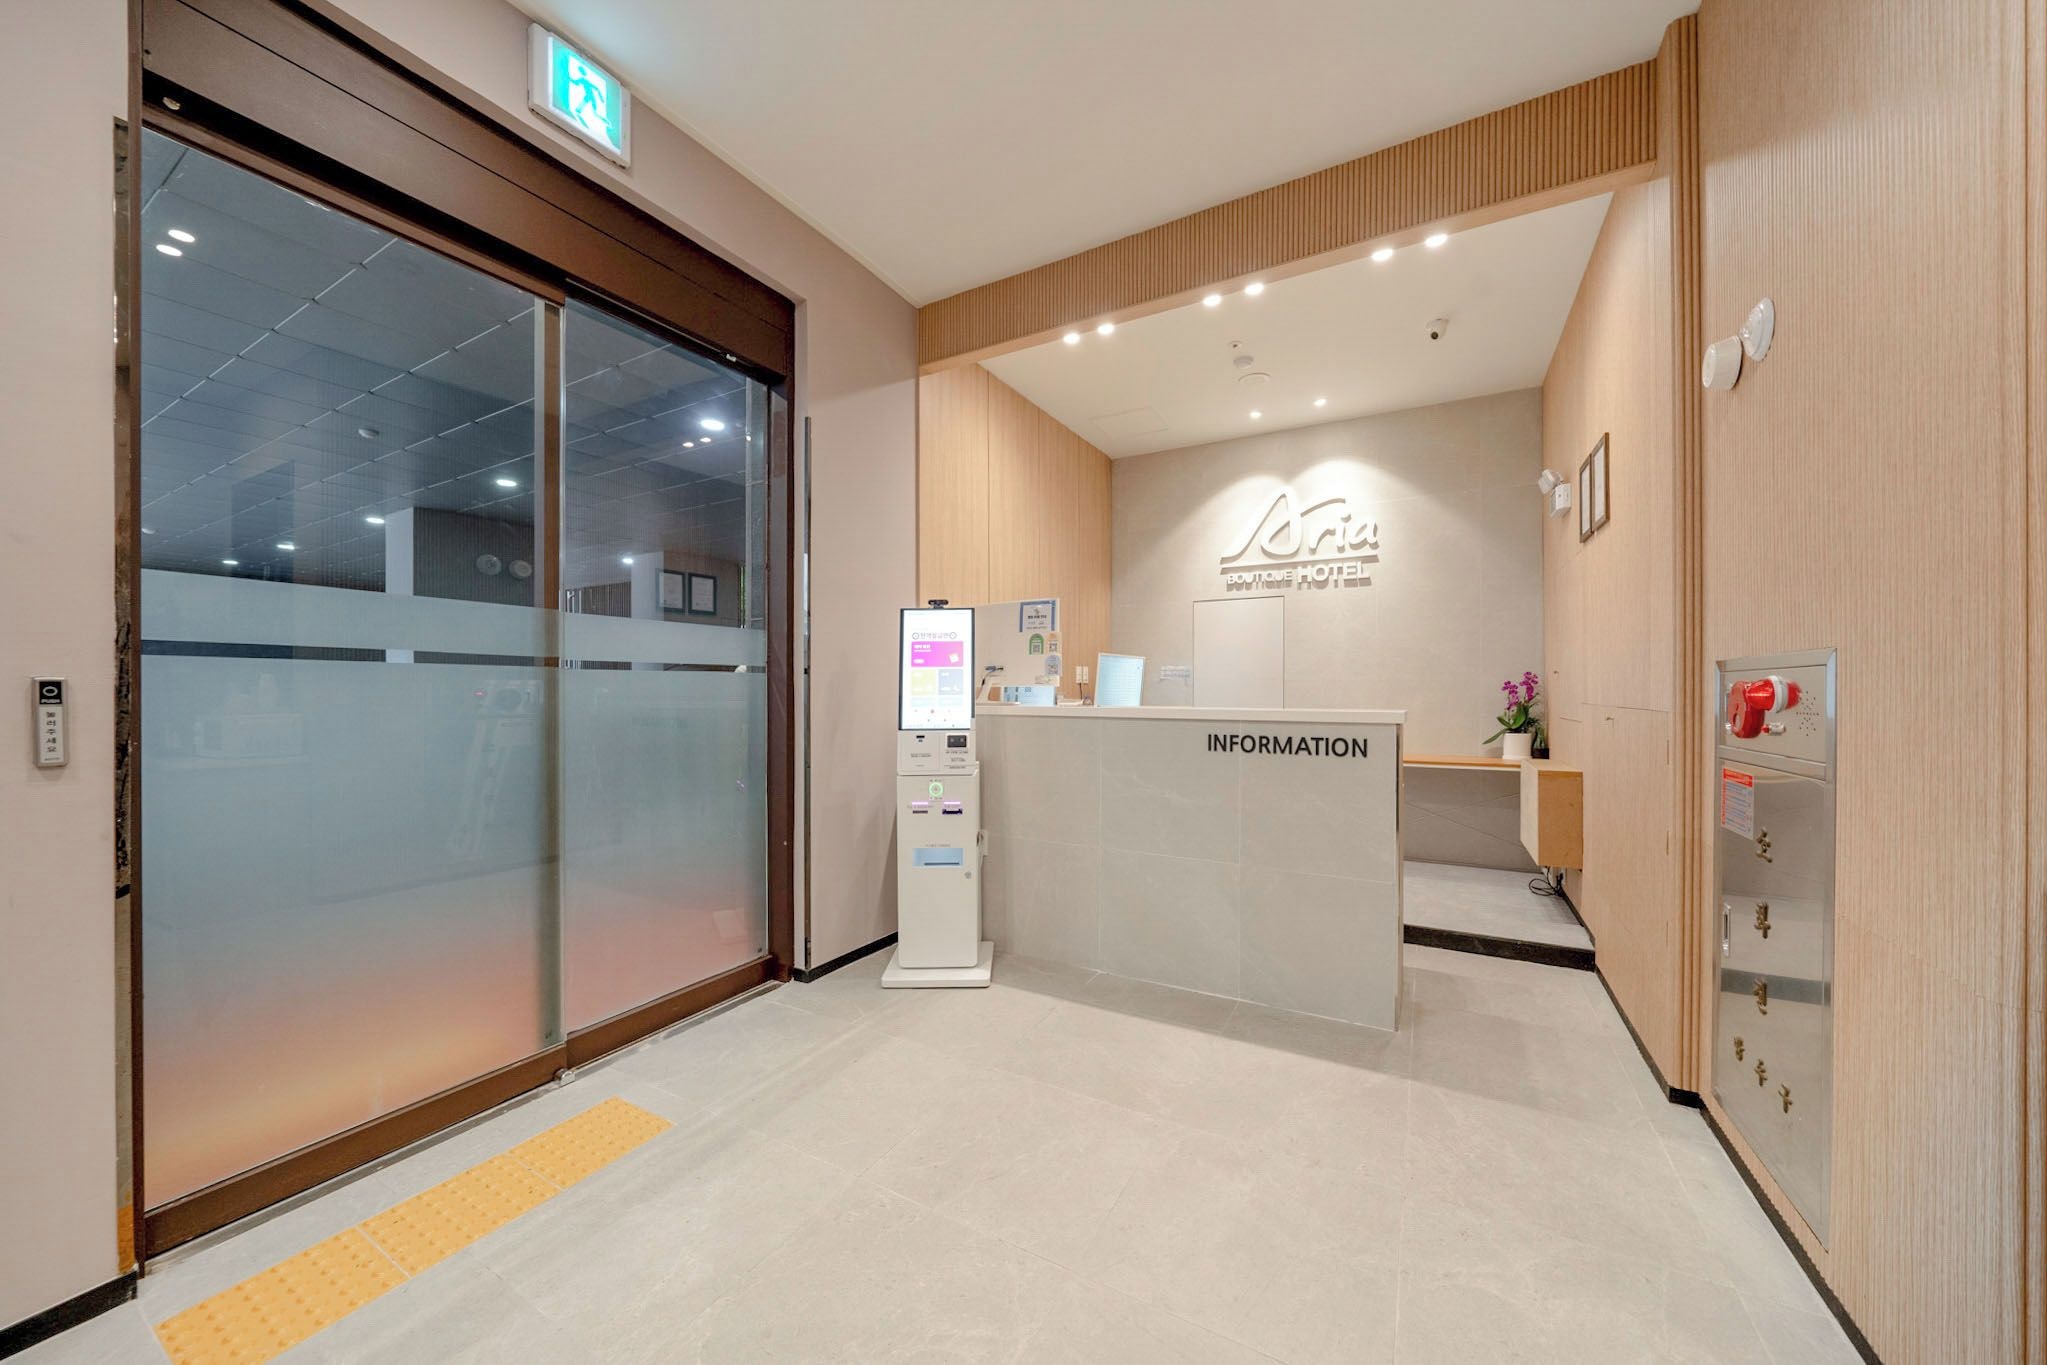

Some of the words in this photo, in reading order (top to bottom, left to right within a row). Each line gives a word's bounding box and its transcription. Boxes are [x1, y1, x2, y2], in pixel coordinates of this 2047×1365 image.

[1220, 486, 1379, 565] Aria
[1226, 569, 1293, 590] BOUTIQUE
[1297, 561, 1372, 588] HOTEL
[1207, 734, 1368, 758] INFORMATION
